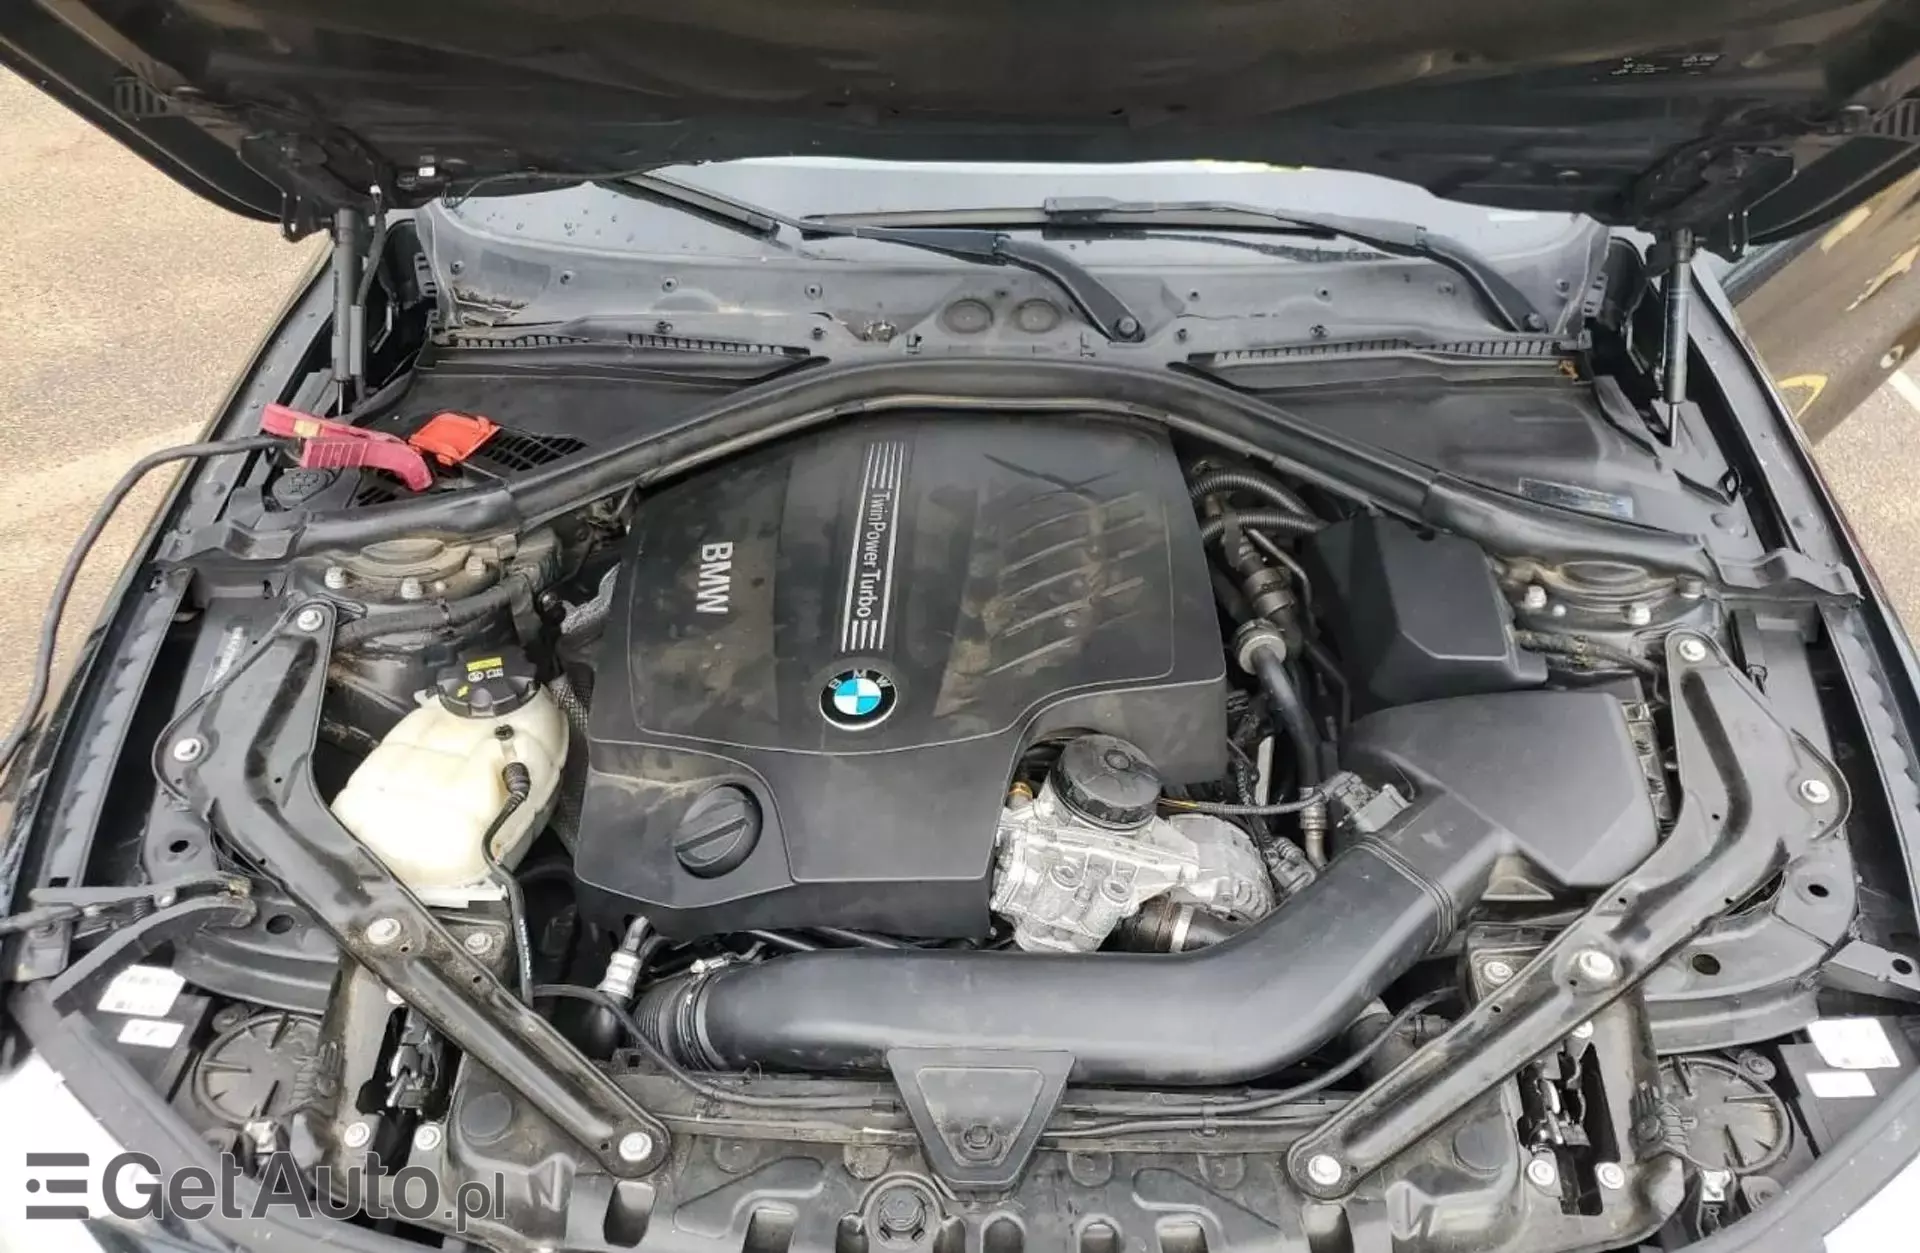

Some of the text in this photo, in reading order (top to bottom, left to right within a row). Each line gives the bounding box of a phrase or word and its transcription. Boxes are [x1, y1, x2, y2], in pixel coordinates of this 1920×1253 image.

[696, 541, 733, 613] BMW
[857, 491, 891, 618] TwinPower Turbo
[828, 668, 893, 690] BMW
